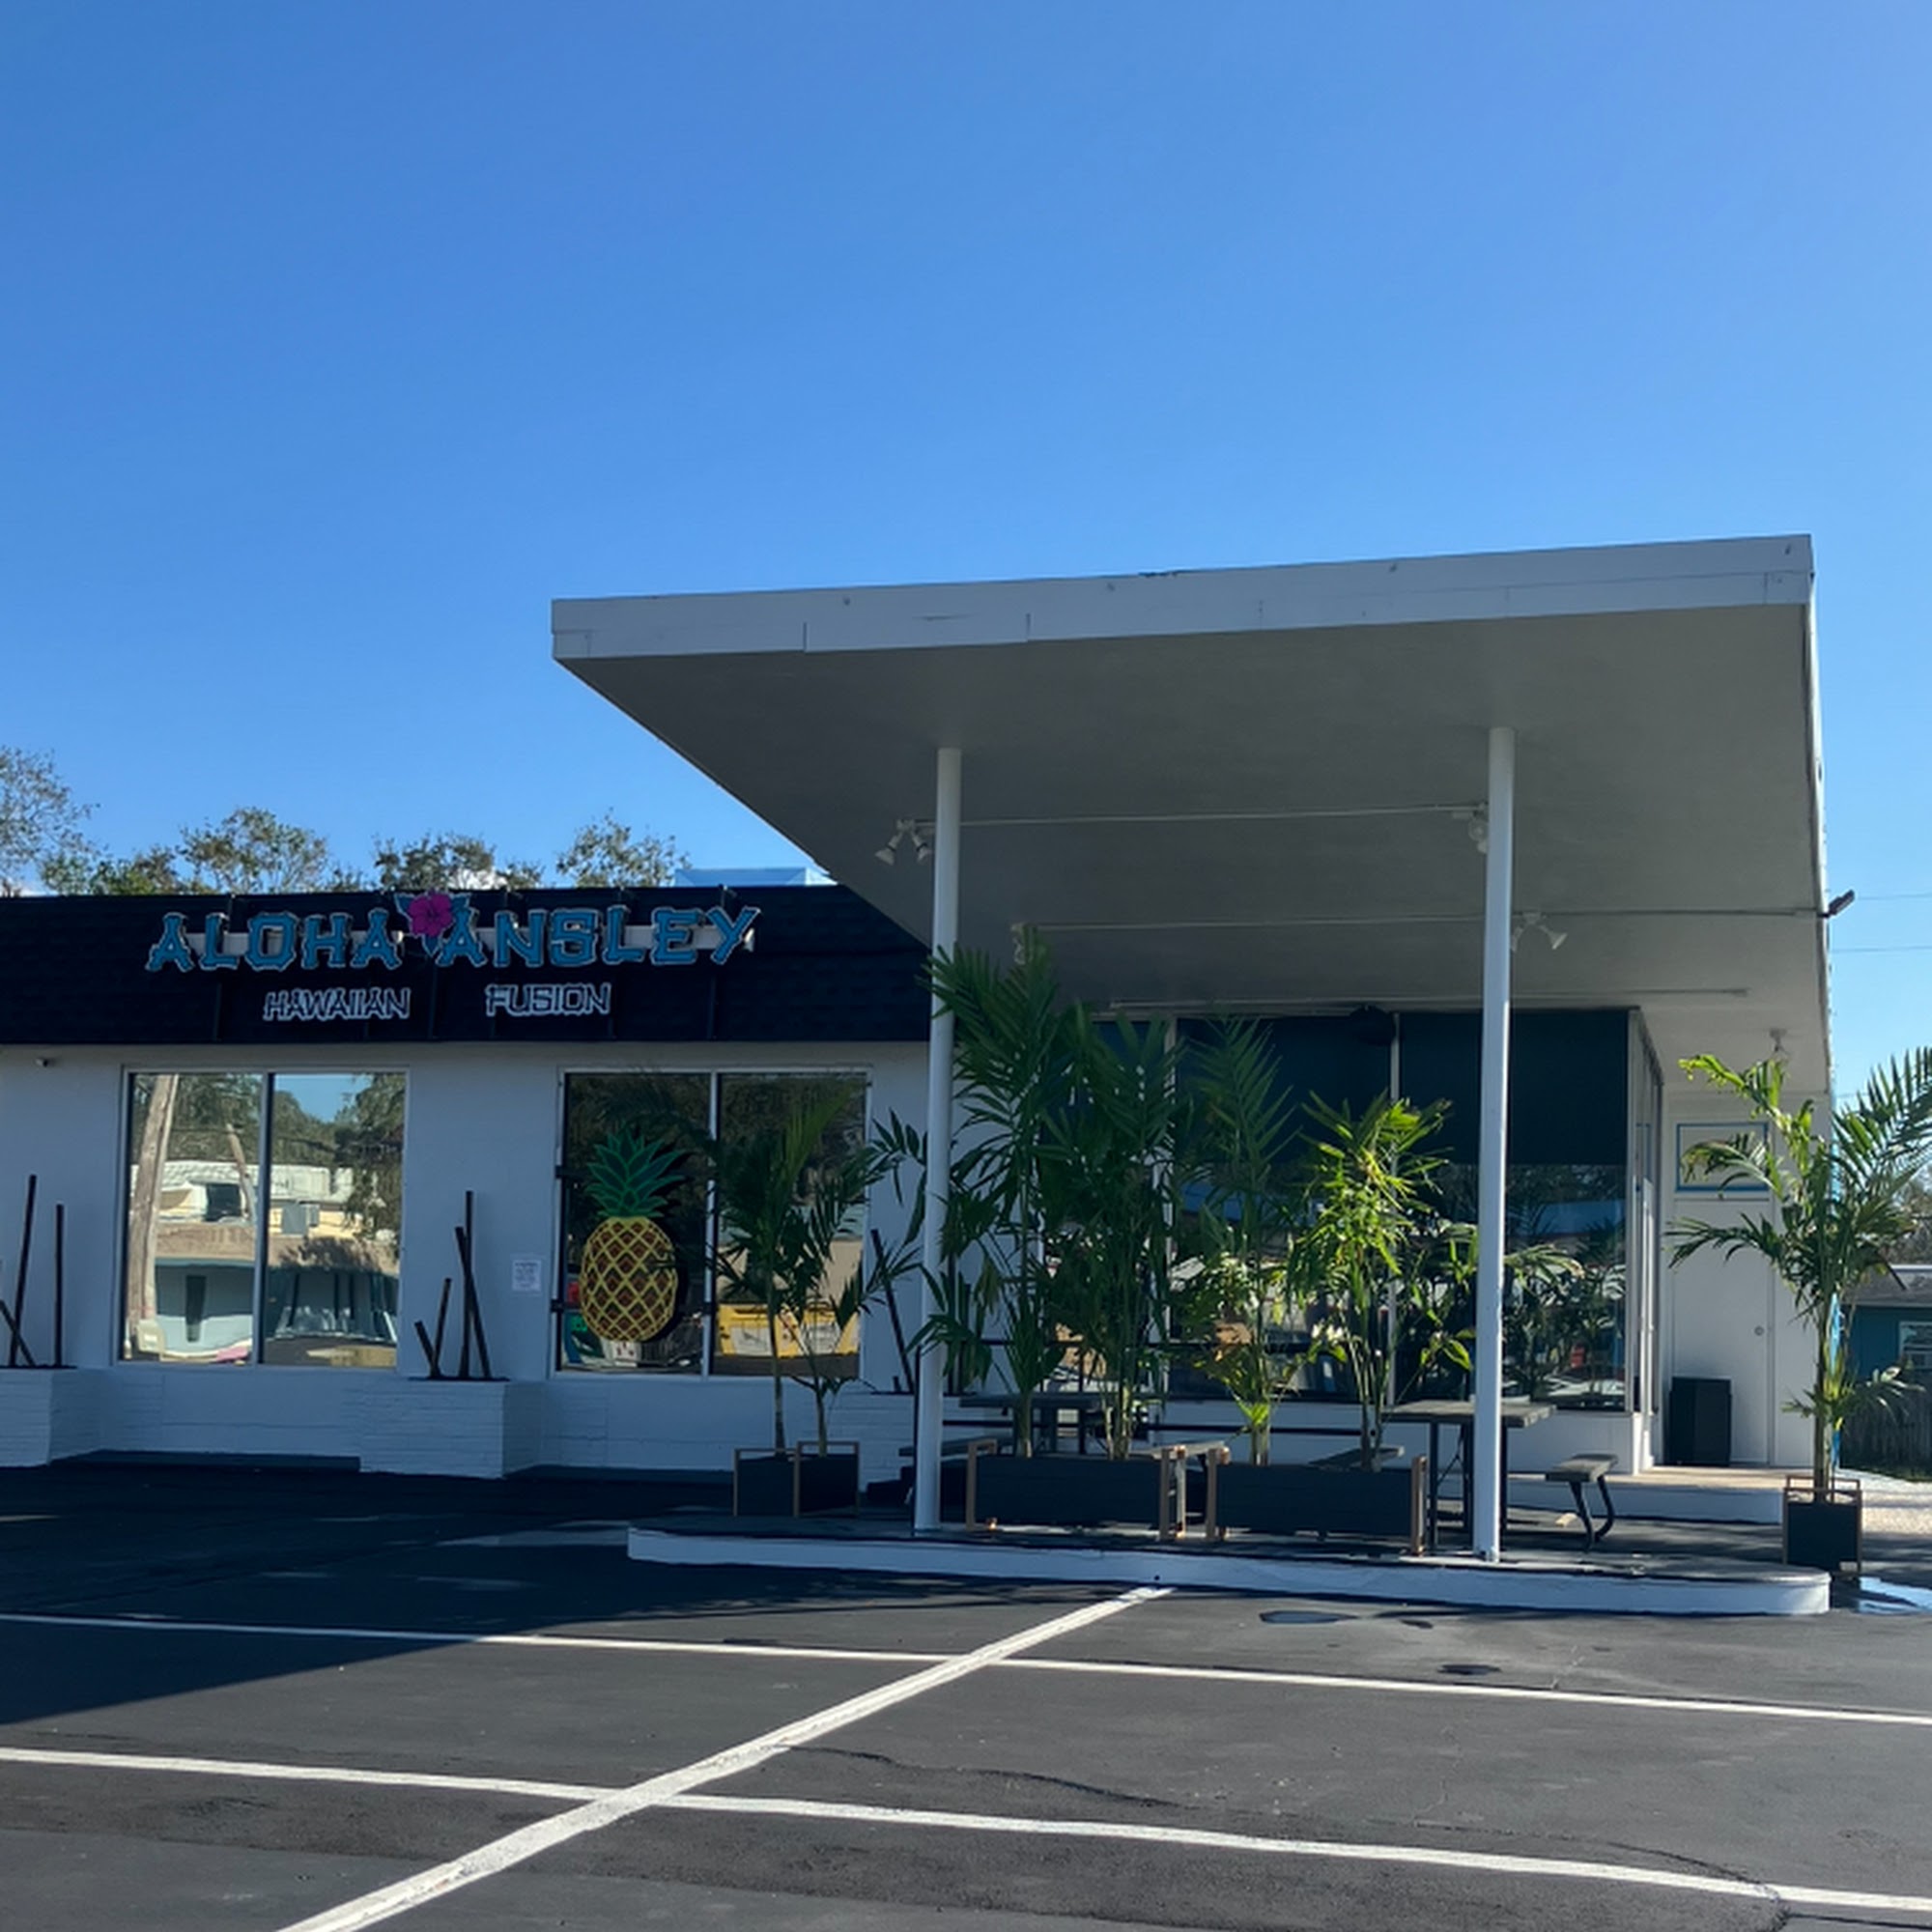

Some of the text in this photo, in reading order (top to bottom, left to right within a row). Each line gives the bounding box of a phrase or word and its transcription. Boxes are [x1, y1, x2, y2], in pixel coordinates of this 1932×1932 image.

[146, 906, 760, 971] ALOHA ANSLEY
[264, 983, 611, 1021] HAWAIIAN FUSION
